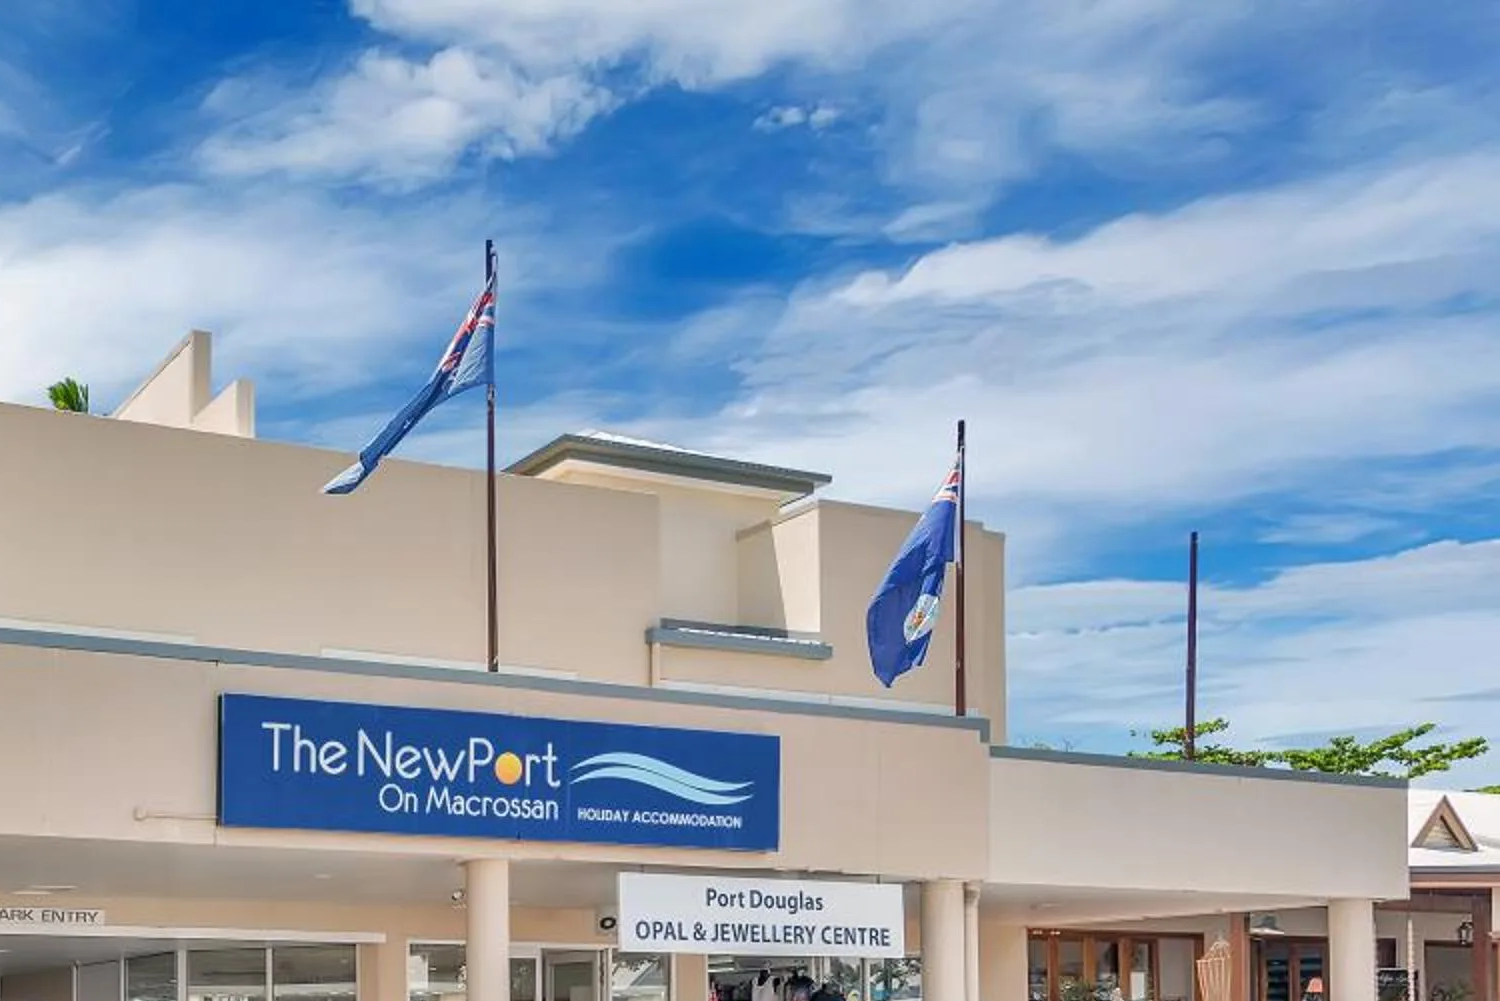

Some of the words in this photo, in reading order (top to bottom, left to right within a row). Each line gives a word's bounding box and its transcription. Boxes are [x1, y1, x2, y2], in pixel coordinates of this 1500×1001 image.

[261, 722, 348, 775] The
[357, 728, 561, 787] NewPort
[379, 783, 418, 813] On
[426, 786, 559, 821] Macrossan
[577, 807, 629, 822] HOLIDAY
[632, 810, 743, 829] ACCOMMODATION
[706, 888, 745, 910] Port
[749, 889, 823, 915] Douglas
[41, 909, 99, 923] ENTRY
[635, 920, 689, 942] OPAL
[693, 921, 706, 941] &
[711, 922, 816, 946] JEWELLERY
[821, 926, 891, 947] CENTRE
